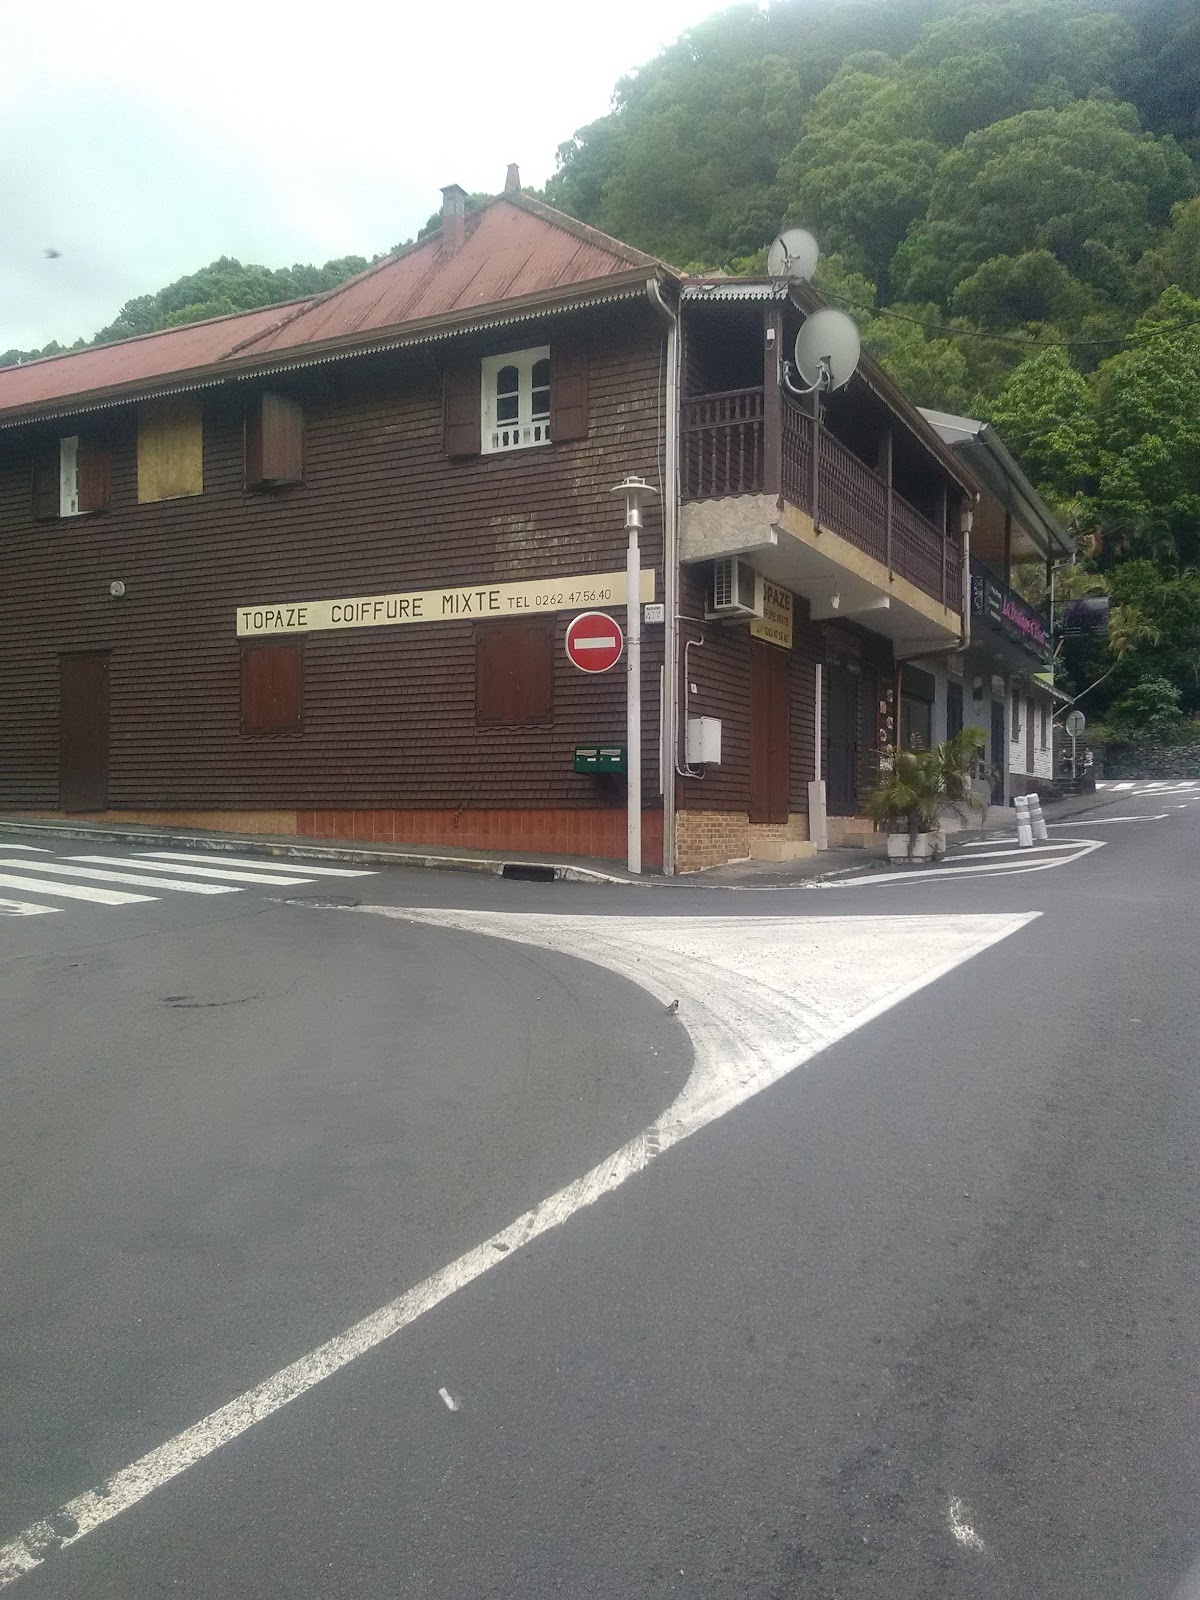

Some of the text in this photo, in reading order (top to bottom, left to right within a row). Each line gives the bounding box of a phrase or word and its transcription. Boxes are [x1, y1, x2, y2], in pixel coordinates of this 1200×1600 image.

[242, 607, 308, 630] TOPAZE
[331, 598, 423, 623] COIFFURE
[441, 590, 501, 614] MIXTE
[507, 596, 530, 608] TEL
